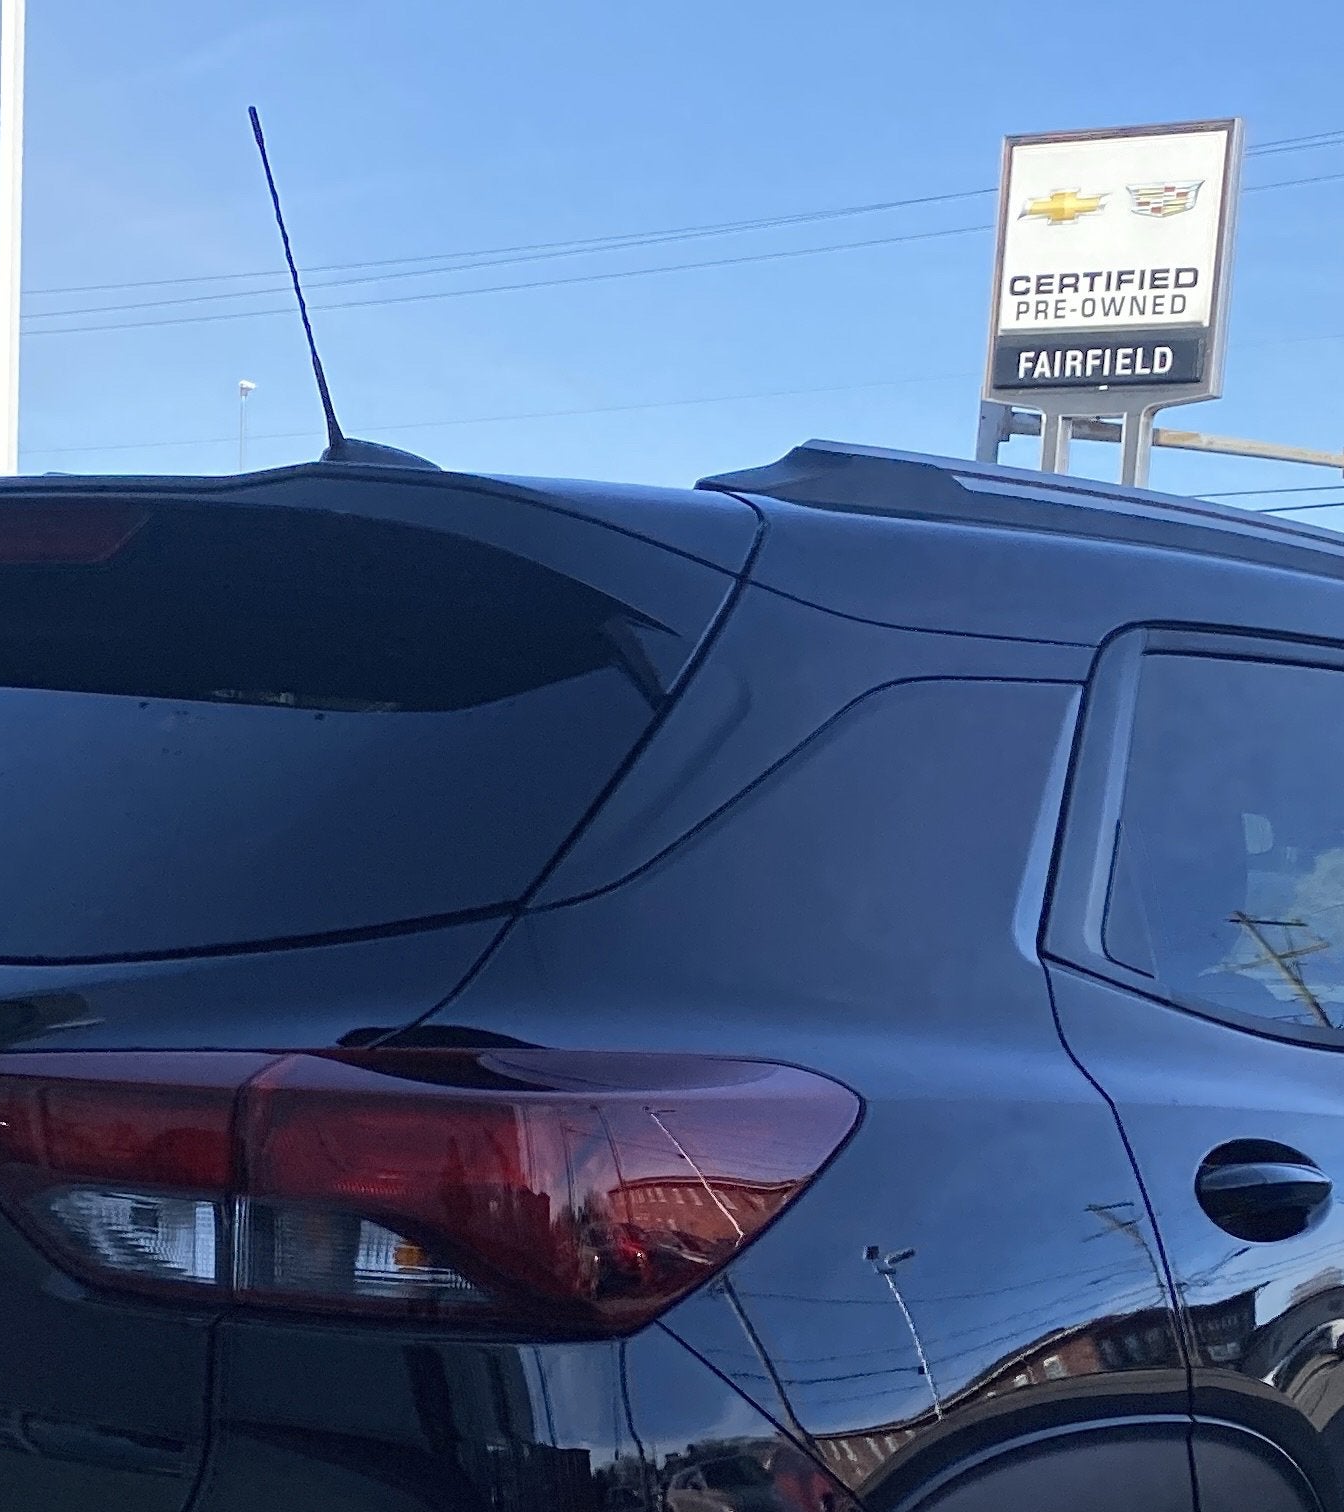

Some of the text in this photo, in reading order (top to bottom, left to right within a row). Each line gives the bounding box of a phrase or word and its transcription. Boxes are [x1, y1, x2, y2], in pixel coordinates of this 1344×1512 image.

[1009, 267, 1200, 296] CERTIFIED
[1015, 294, 1187, 321] PRE-OWNED
[1018, 346, 1174, 379] FAIRFIELD
